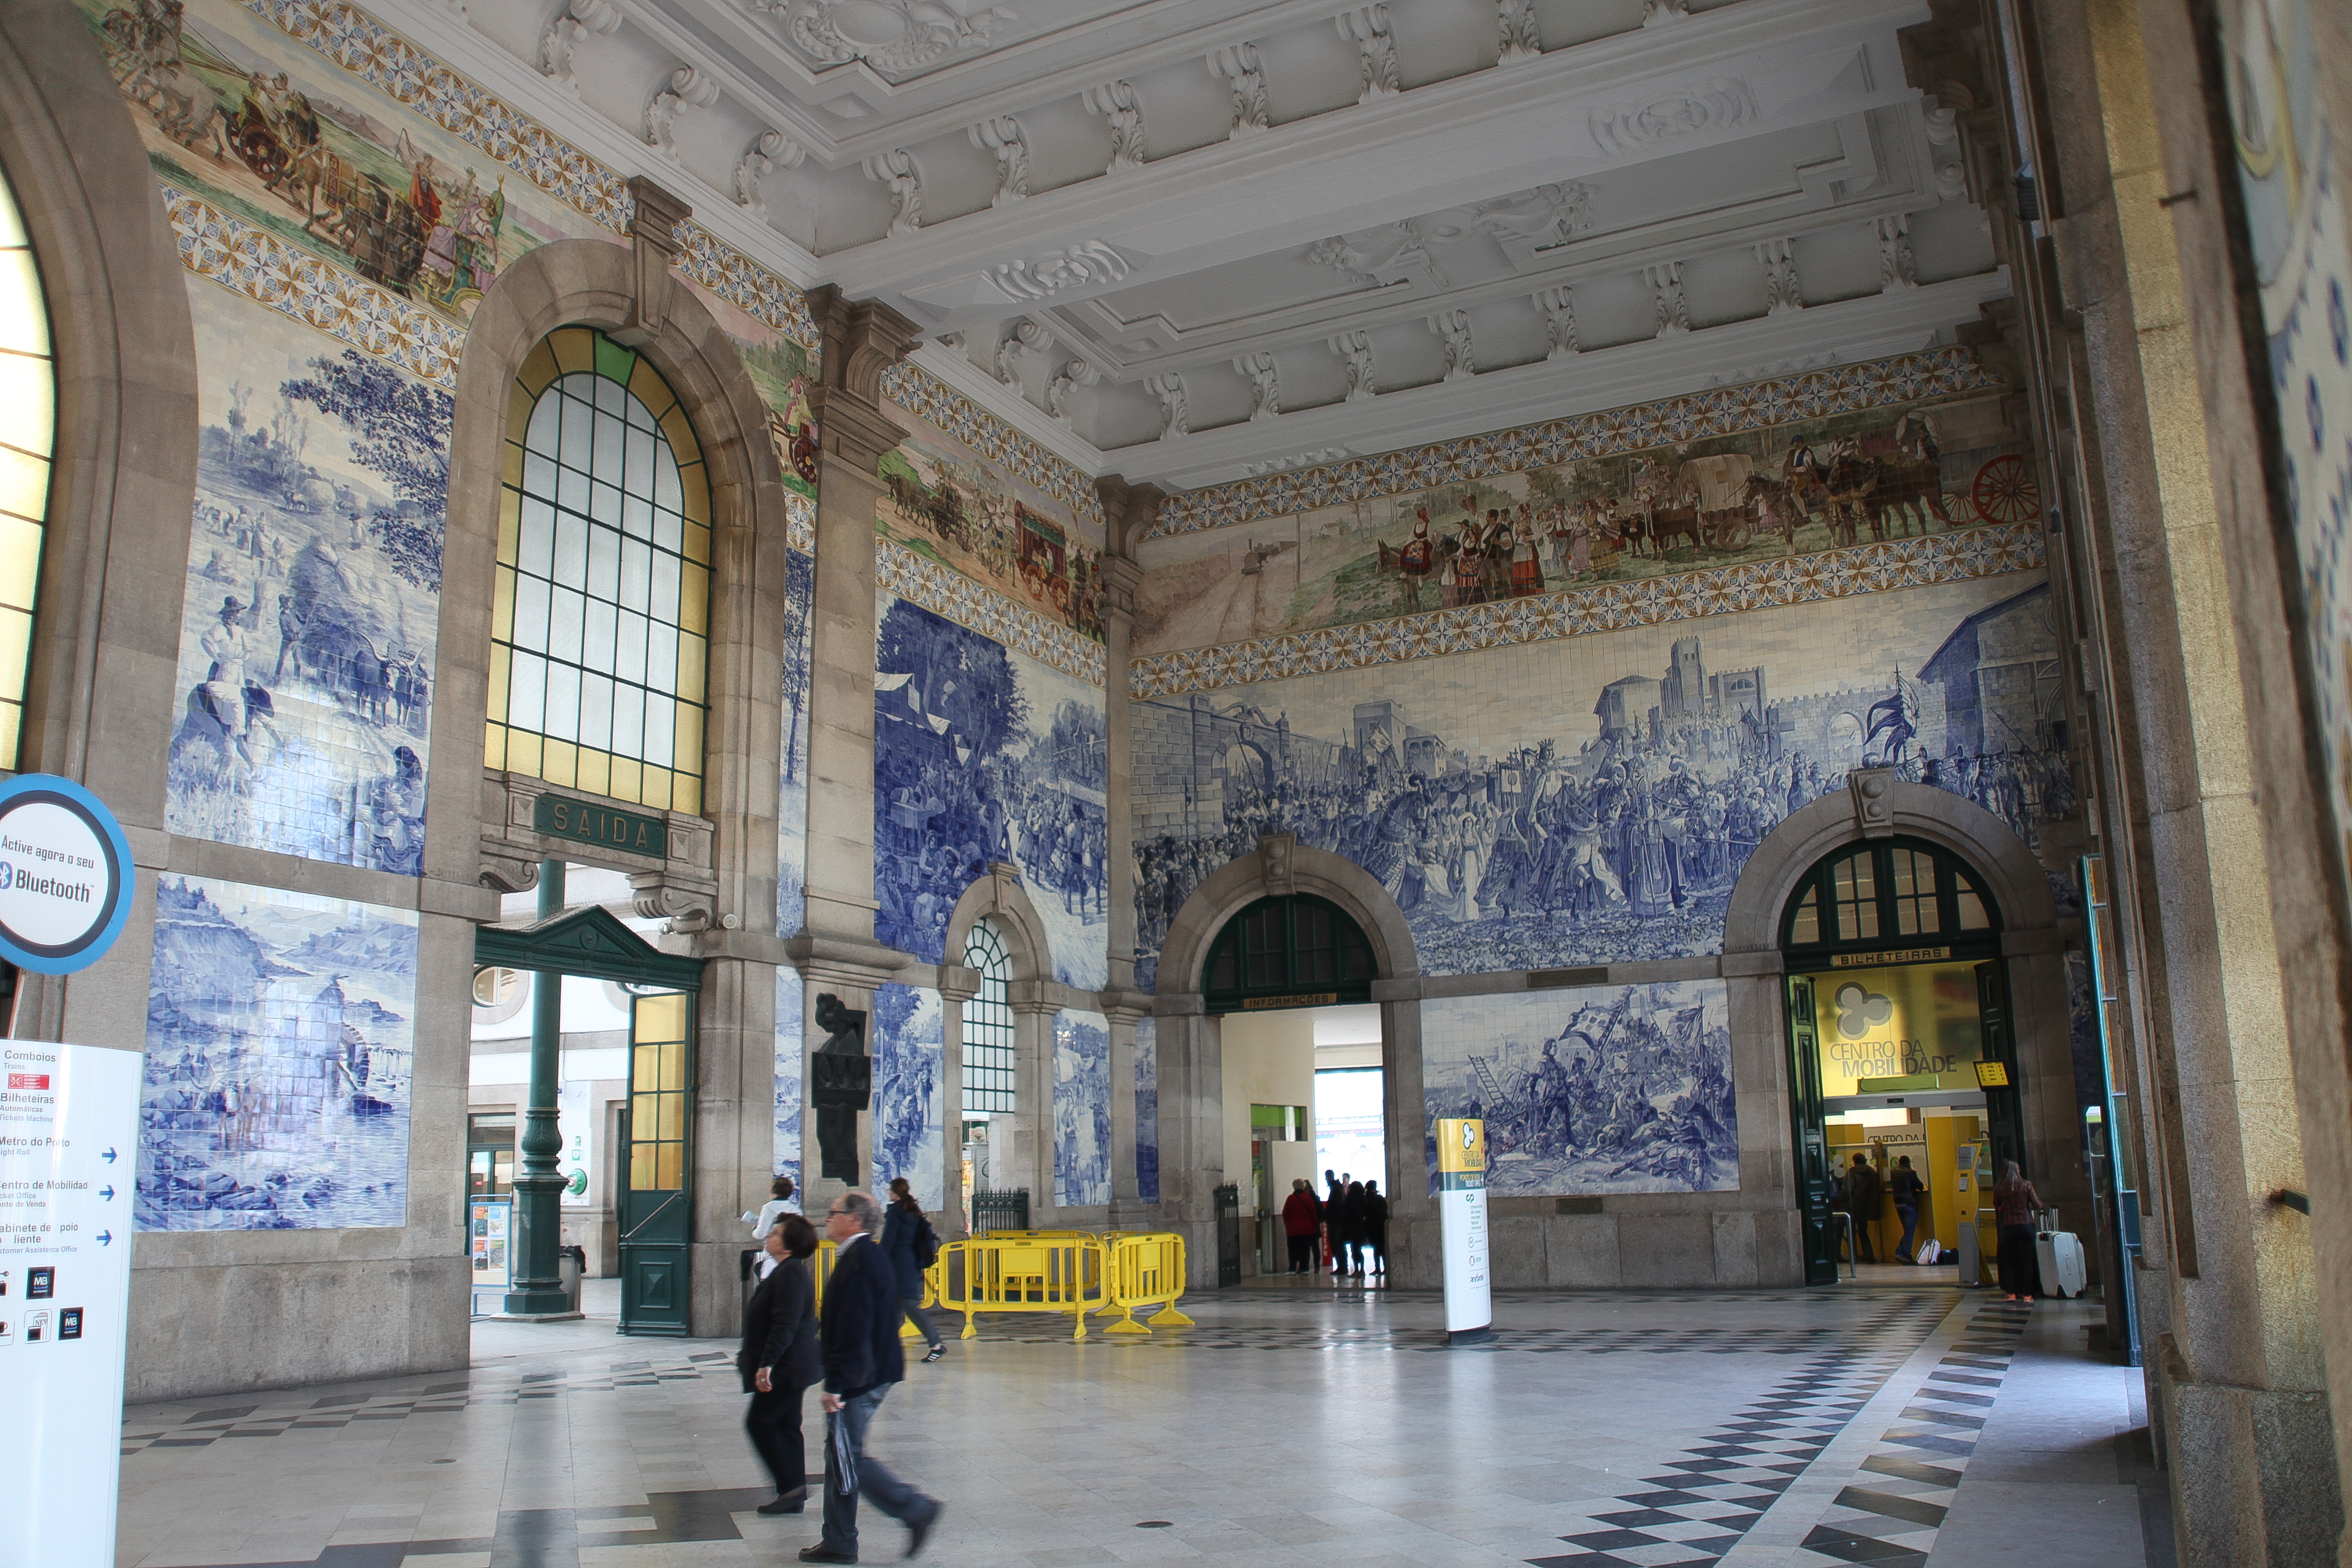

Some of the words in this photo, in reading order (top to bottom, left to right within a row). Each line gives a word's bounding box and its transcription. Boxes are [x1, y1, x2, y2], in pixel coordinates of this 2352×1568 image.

[554, 804, 647, 849] SAIDA
[1, 835, 33, 854] Active
[36, 847, 65, 862] agora
[68, 855, 74, 864] o
[77, 857, 94, 869] seu
[16, 869, 90, 903] Bluetooth
[1841, 949, 1942, 965] BILHETEIRAS
[1249, 995, 1328, 1007] INFORMAÇÕES
[1830, 1041, 1896, 1060] CENTRO
[1900, 1039, 1925, 1057] DA
[5, 1050, 56, 1062] Comboios
[1843, 1055, 1957, 1077] MOBILIDADE
[0, 1093, 54, 1104] Bilheteiras
[0, 1136, 27, 1145] Metro
[31, 1137, 42, 1146] do
[46, 1137, 70, 1147] Porto
[0, 1181, 29, 1189] entro
[33, 1180, 44, 1189] de
[47, 1180, 88, 1189] Mobilidad
[40, 1223, 51, 1231] de
[34, 1277, 48, 1286] MB
[65, 1317, 77, 1326] MB
